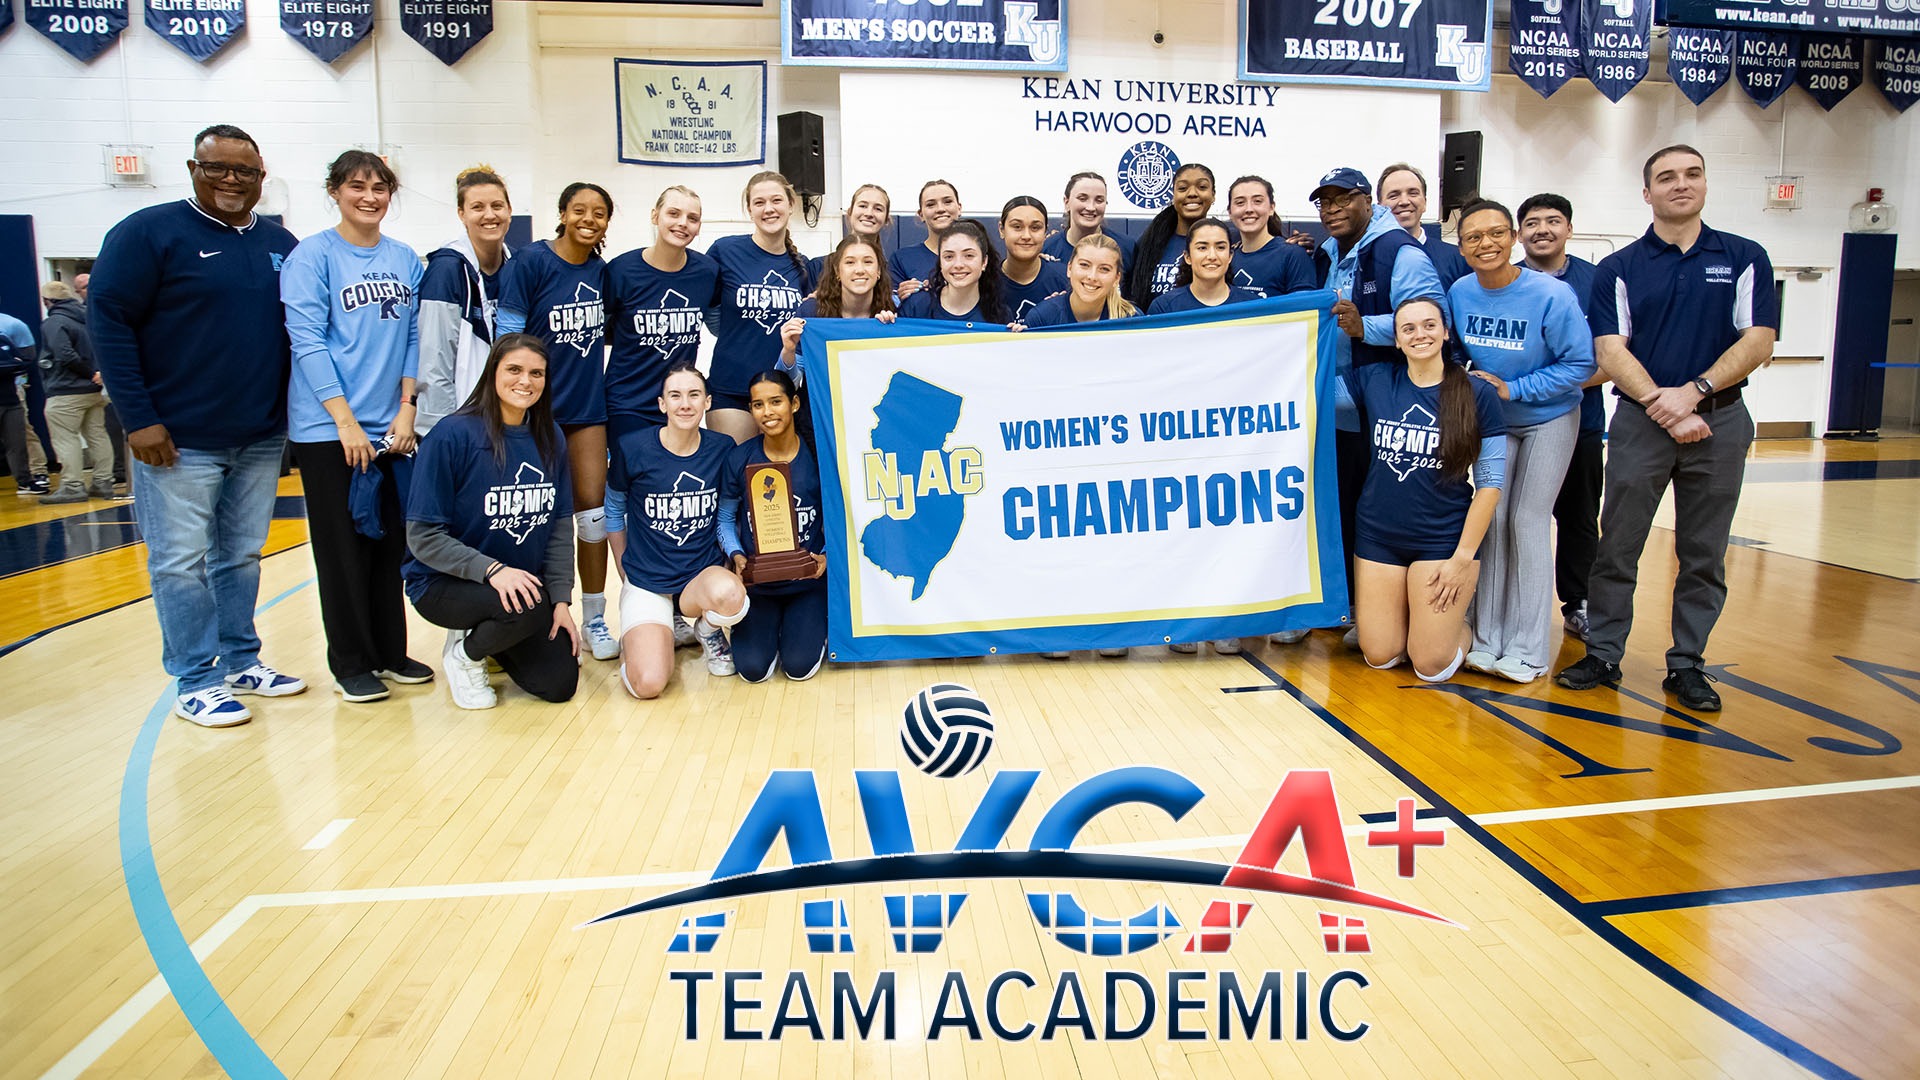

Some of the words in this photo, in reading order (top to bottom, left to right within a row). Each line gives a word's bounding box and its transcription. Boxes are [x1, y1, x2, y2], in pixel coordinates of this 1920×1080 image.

[31, 0, 74, 8] ELITE
[84, 0, 124, 9] EIGHT
[151, 0, 192, 10] ELITE
[196, 0, 241, 11] EIGHT
[284, 3, 323, 14] ELITE
[327, 3, 370, 14] EIGHT
[405, 4, 443, 15] ELITE
[447, 4, 489, 15] EIGHT
[1313, 0, 1422, 28] 2007
[1530, 15, 1561, 24] SOFTBALL
[1715, 8, 1815, 25] www.kean.edu
[1837, 15, 1920, 32] www.keanat
[49, 14, 108, 34] 2008
[169, 17, 227, 35] 2010
[302, 20, 354, 38] 1978
[423, 22, 471, 38] 1991
[801, 18, 885, 42] MEN'S
[892, 19, 996, 44] SOCCER
[1603, 19, 1634, 27] SOFTBALL
[1520, 30, 1570, 48] NCAA
[1594, 32, 1642, 49] NCAA
[1676, 35, 1722, 53] NCAA
[1284, 38, 1404, 63] BASEBALL
[1511, 45, 1545, 56] WORLD
[1547, 47, 1580, 58] SERIES
[1588, 49, 1617, 58] WORLD
[1618, 51, 1649, 59] SERIES
[1743, 40, 1788, 57] NCAA
[1807, 43, 1852, 60] NCAA
[1671, 51, 1700, 62] FINAL
[1701, 53, 1729, 65] FOUR
[1737, 56, 1764, 67] FINAL
[1767, 58, 1796, 68] FOUR
[1800, 60, 1830, 69] WORLD
[1831, 60, 1859, 70] SERIES
[1875, 60, 1903, 72] WORLD
[1524, 61, 1566, 78] 2015
[1597, 65, 1635, 81] 1986
[1679, 67, 1717, 84] 1984
[1747, 71, 1783, 88] 1987
[1809, 75, 1849, 90] 2008
[1885, 77, 1920, 94] 2009
[1022, 76, 1101, 100] KEAN
[1114, 79, 1281, 107] UNIVERSITY
[670, 117, 714, 128] WRESTLING
[1035, 110, 1172, 135] HARWOOD
[1183, 115, 1267, 138] ARENA
[652, 129, 688, 140] NATIONAL
[693, 130, 732, 141] CHAMPION
[645, 142, 669, 153] FRANK
[1129, 141, 1171, 157] KEAN
[115, 156, 138, 173] EXIT
[1118, 171, 1175, 209] UNIVERSI
[1778, 184, 1795, 199] EXIT
[362, 272, 399, 281] KEAN
[1465, 314, 1529, 341] KEAN
[1464, 335, 1524, 351] VOLLEYBALL
[1000, 415, 1129, 451] WOMEN'S
[1139, 401, 1300, 443] VOLLEYBALL
[864, 447, 984, 520] NJAC
[763, 504, 780, 512] 2025
[1002, 465, 1304, 541] CHAMPIONS
